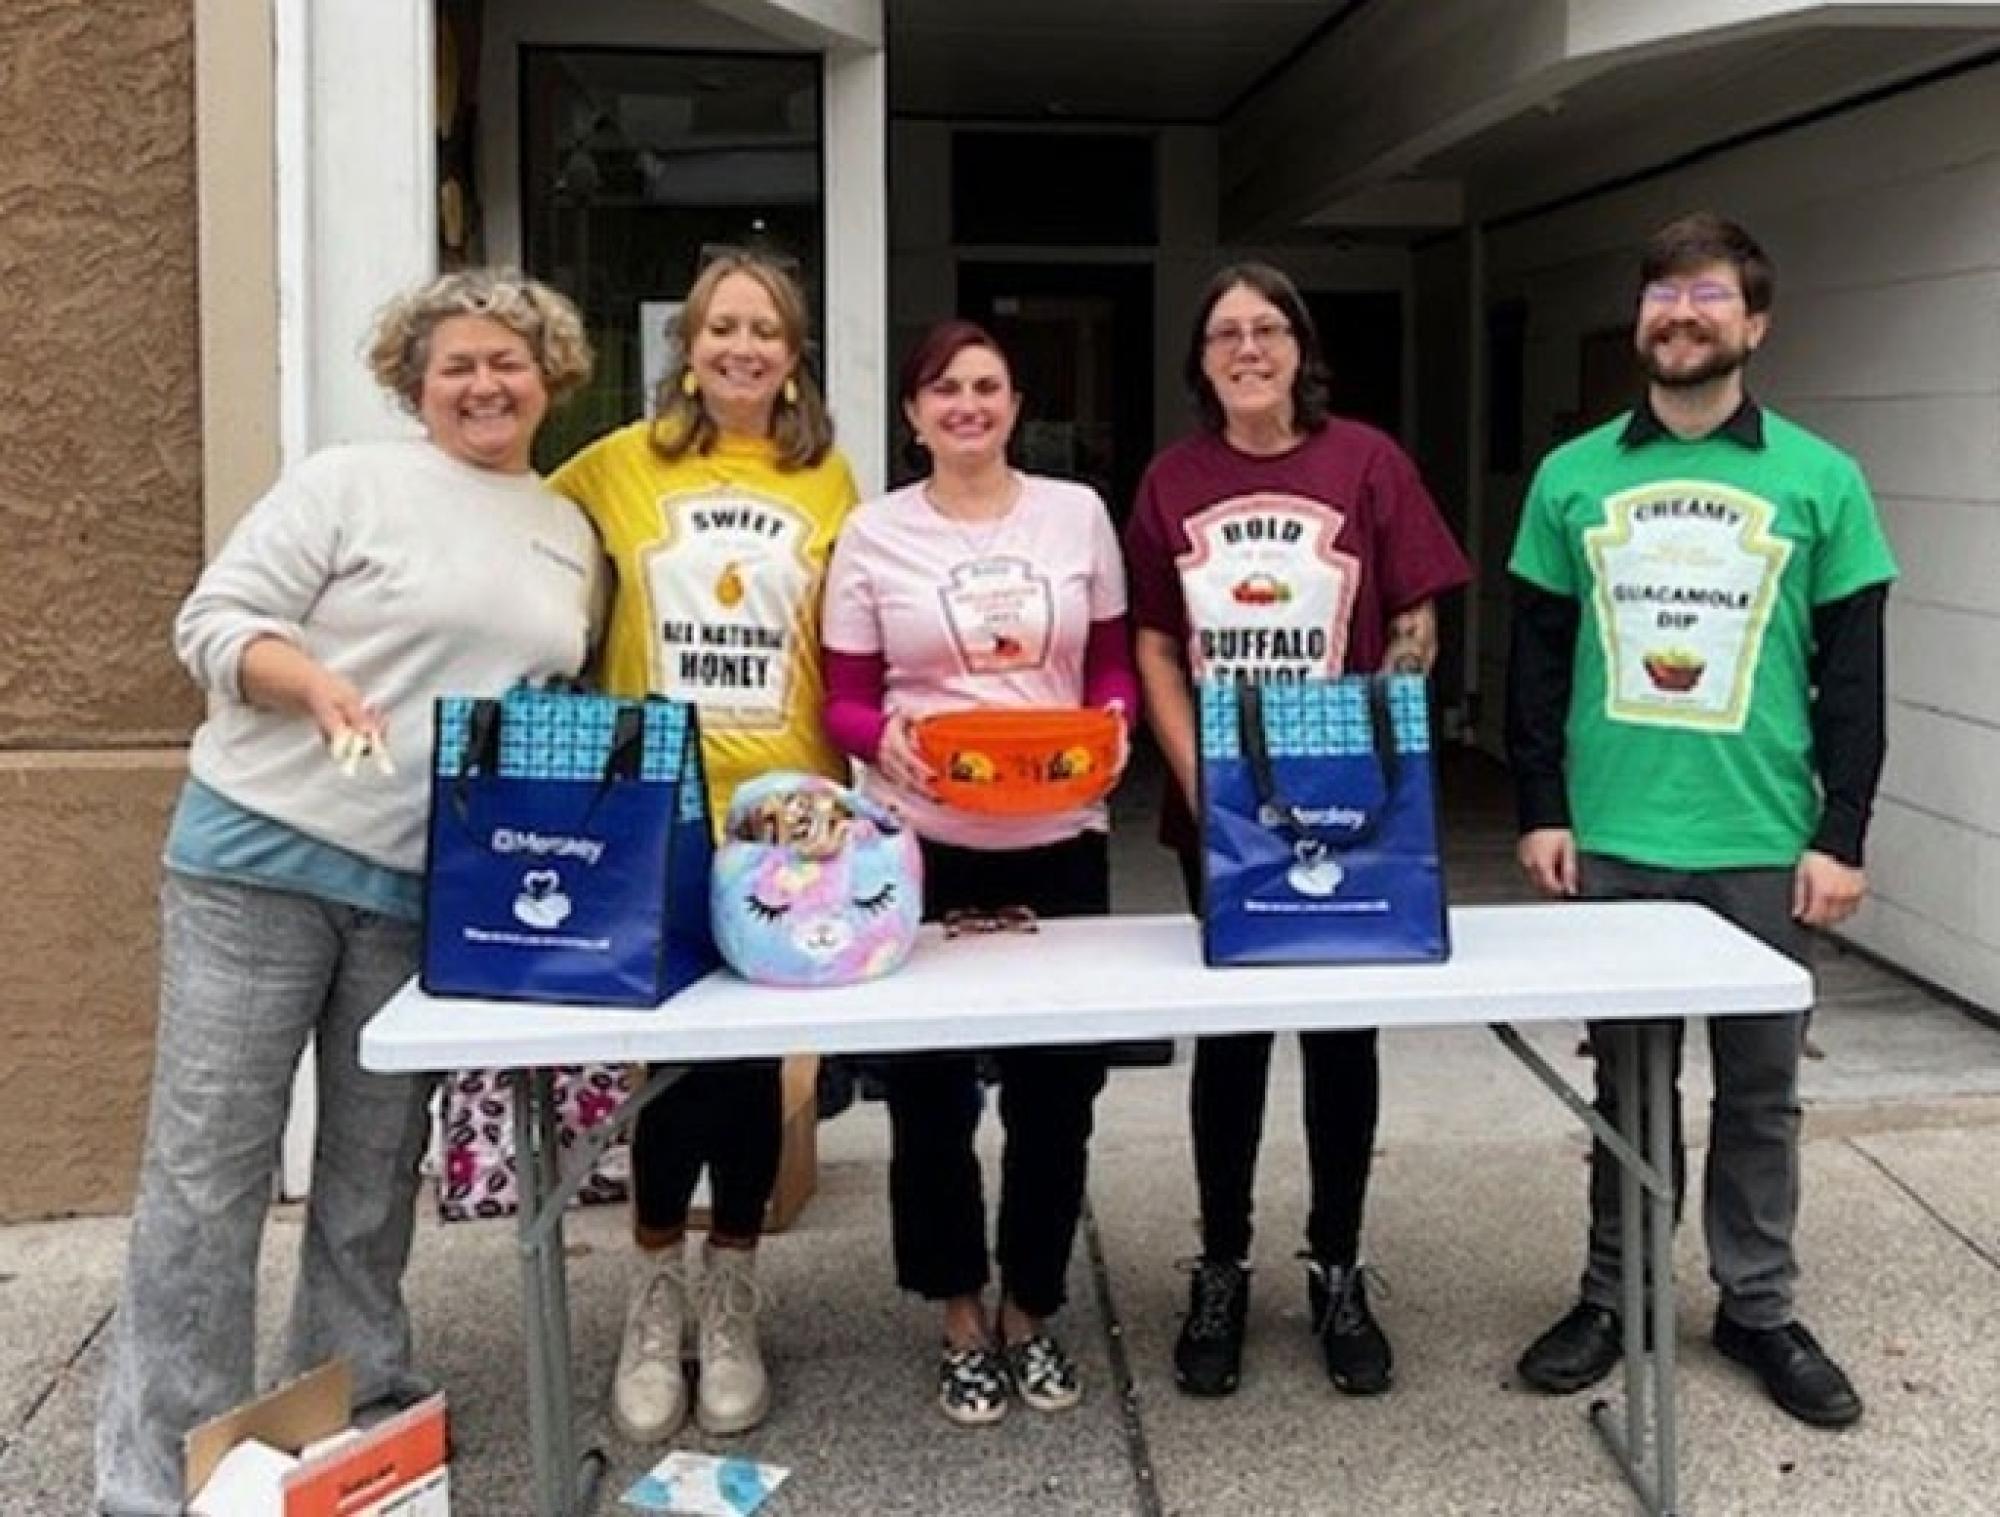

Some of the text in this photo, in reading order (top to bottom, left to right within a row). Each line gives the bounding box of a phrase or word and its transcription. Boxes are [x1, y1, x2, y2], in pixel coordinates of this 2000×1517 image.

[691, 508, 784, 537] SWEET
[1634, 499, 1740, 525] CREAMY
[1221, 517, 1304, 544] BOLD
[1613, 585, 1749, 609] GUACAMOLE
[664, 620, 694, 642] ALL
[1657, 611, 1699, 629] DIP
[1200, 629, 1325, 660] BUFFALO
[679, 652, 768, 688] HONEY
